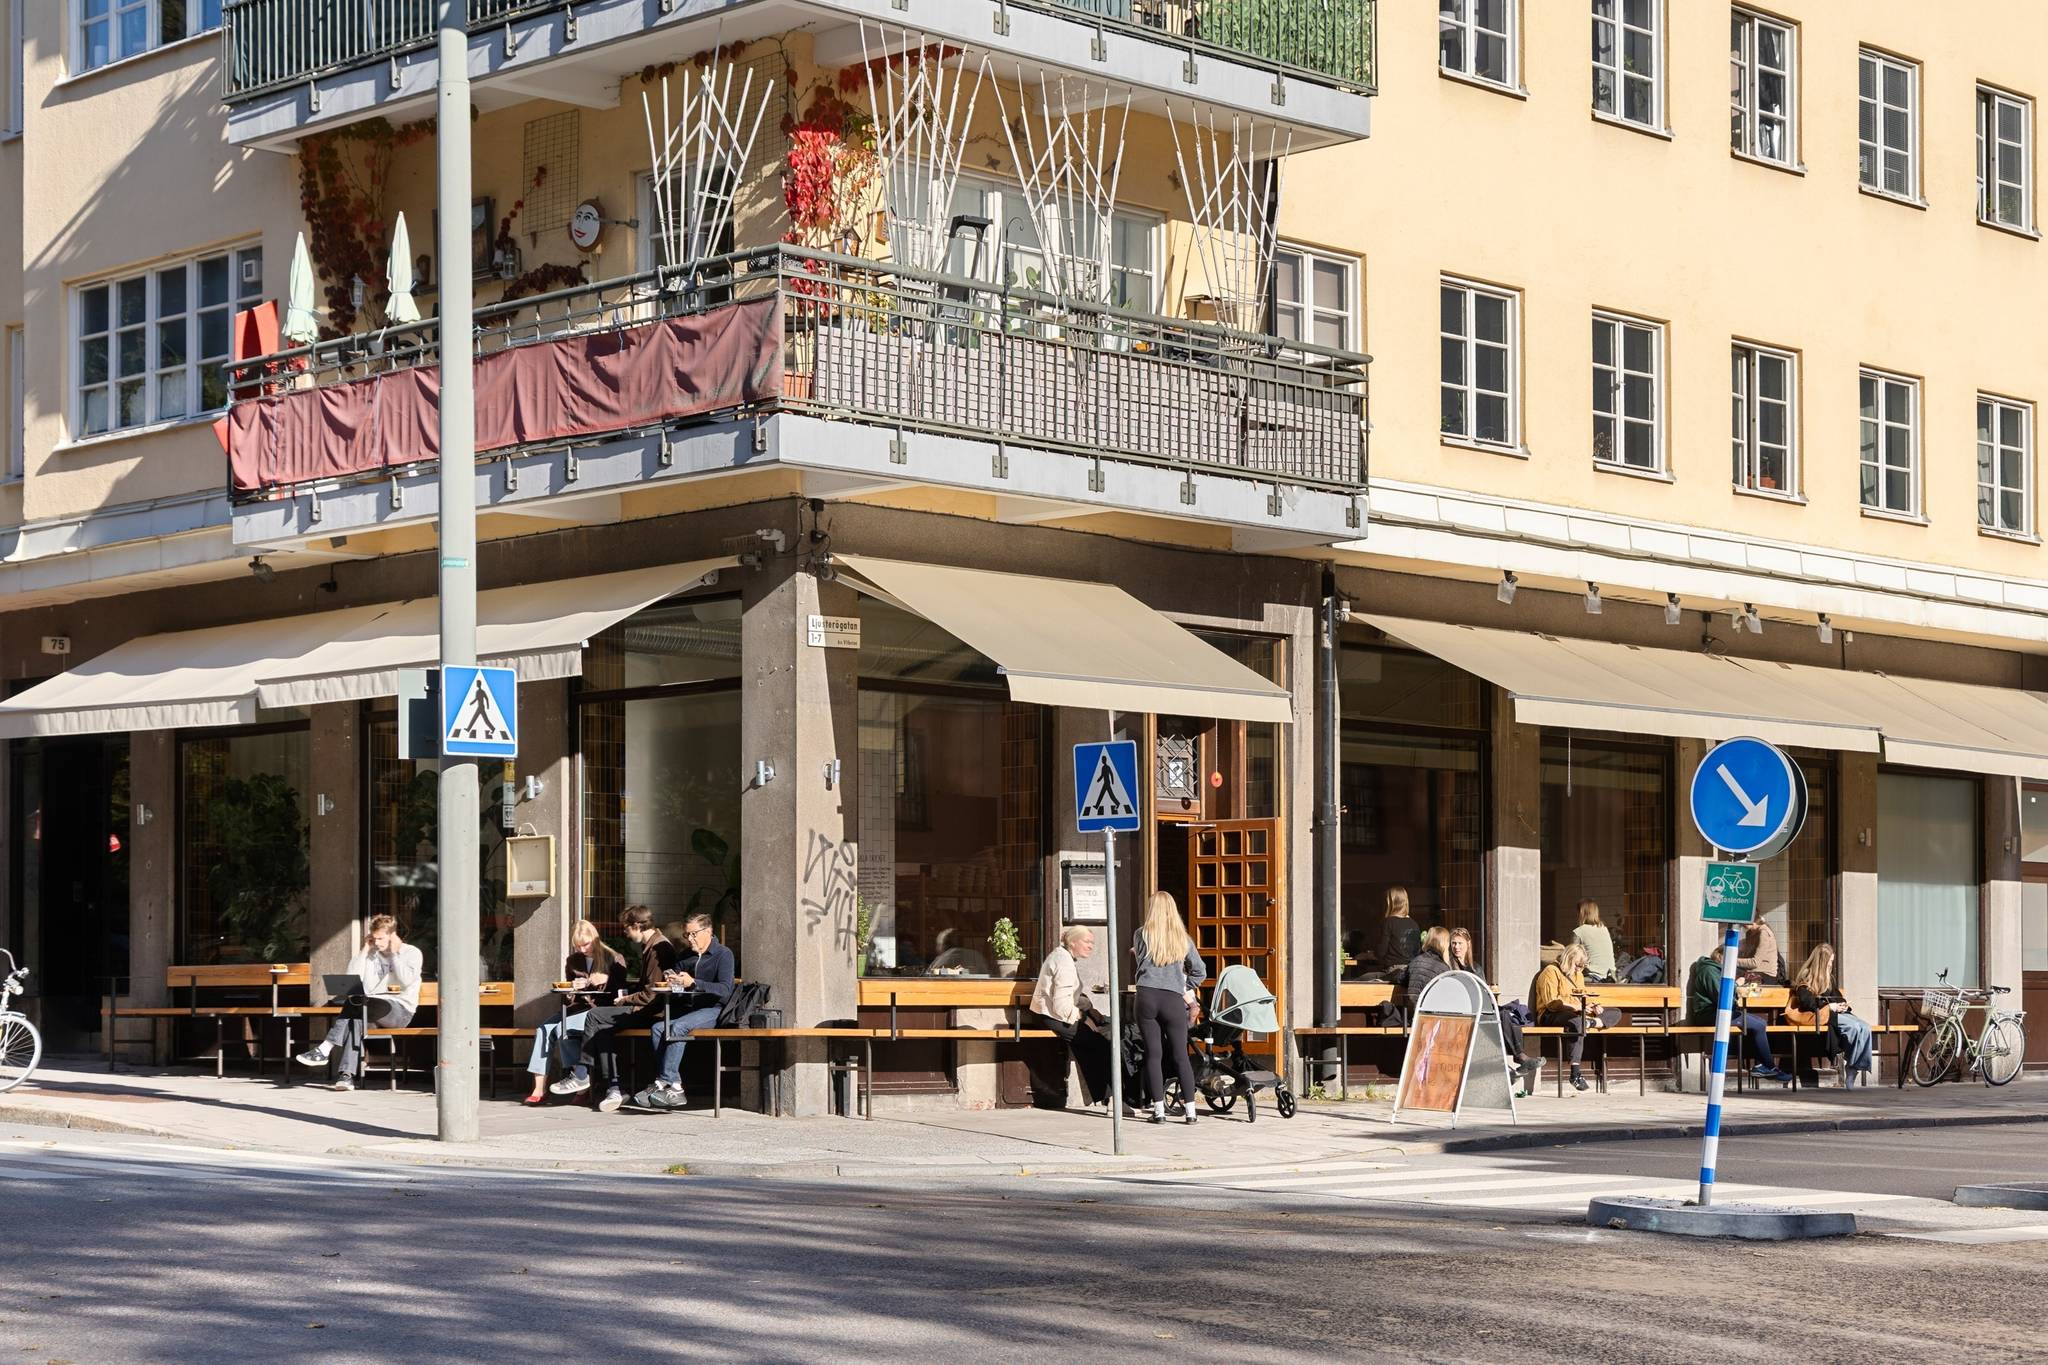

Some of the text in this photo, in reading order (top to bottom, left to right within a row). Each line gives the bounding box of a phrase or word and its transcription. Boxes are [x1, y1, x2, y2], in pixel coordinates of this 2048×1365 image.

[811, 618, 858, 631] Ljusterögatan
[811, 633, 822, 643] 1-7
[51, 639, 65, 650] 75
